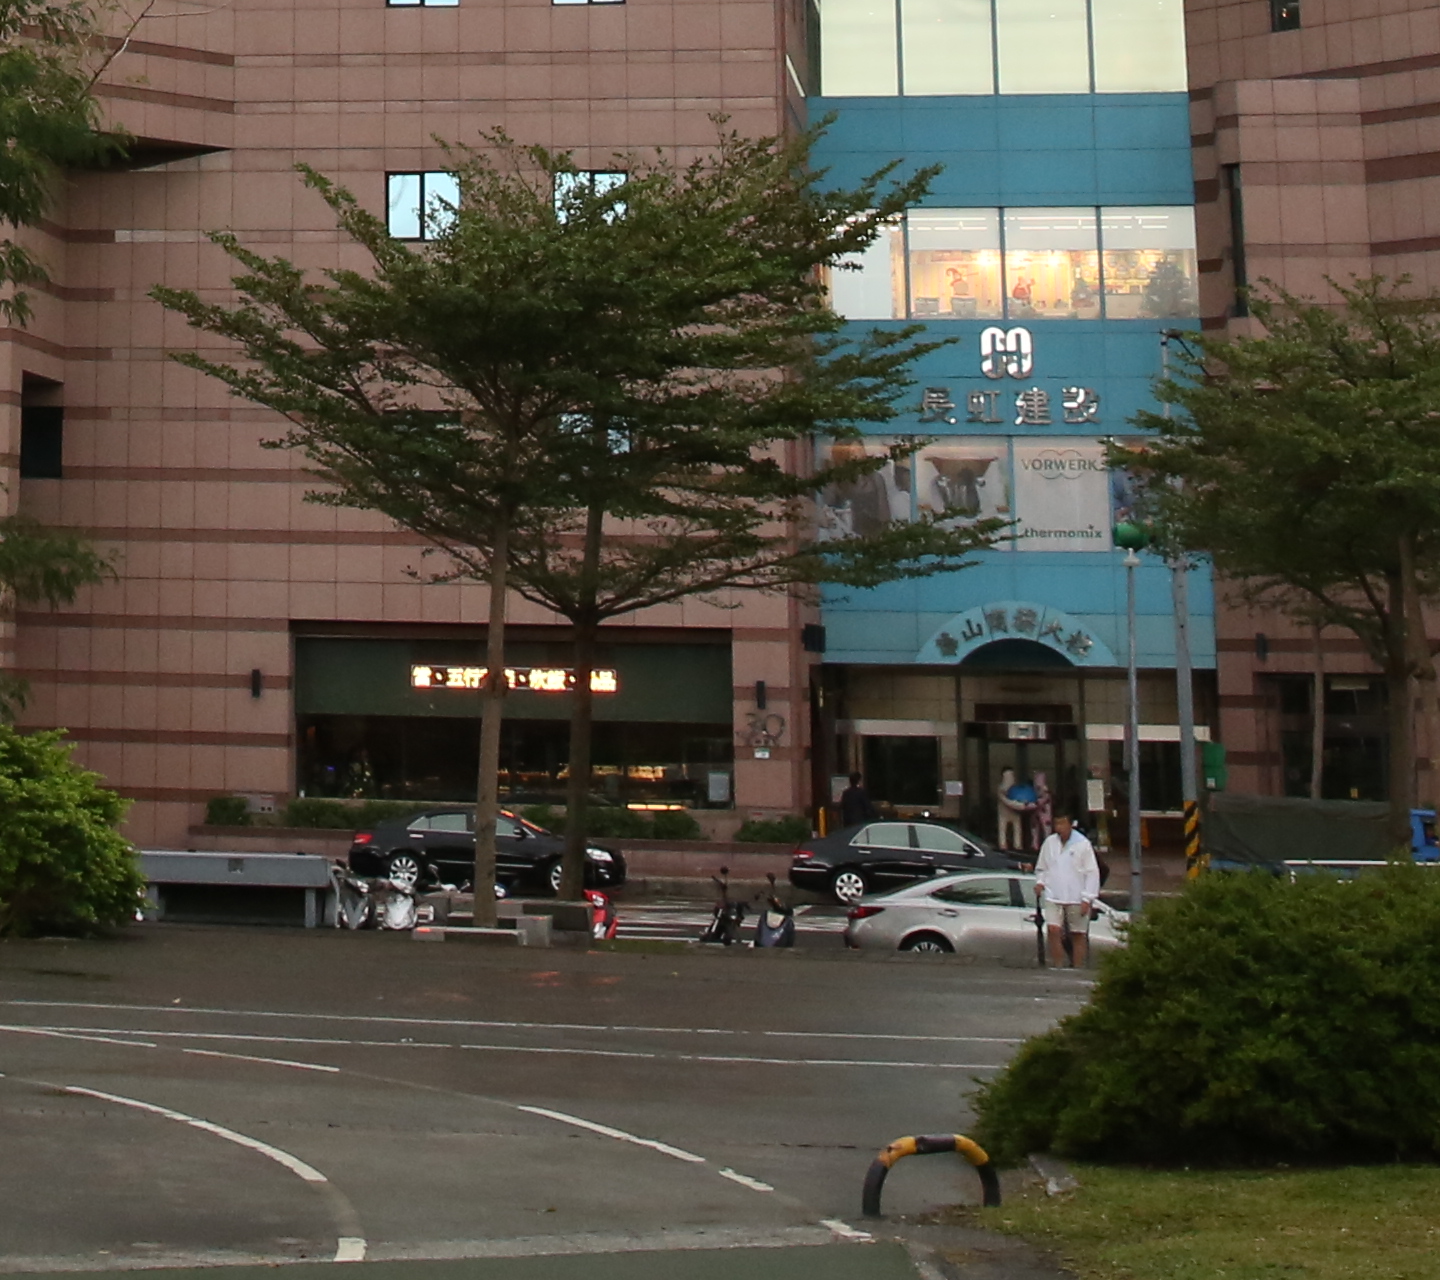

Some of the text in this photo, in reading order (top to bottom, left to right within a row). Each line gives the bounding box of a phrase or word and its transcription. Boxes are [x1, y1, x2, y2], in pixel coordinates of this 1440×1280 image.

[918, 385, 1102, 426] 長虹建設
[1021, 457, 1099, 472] VORWERK
[1023, 524, 1102, 539] thermomix
